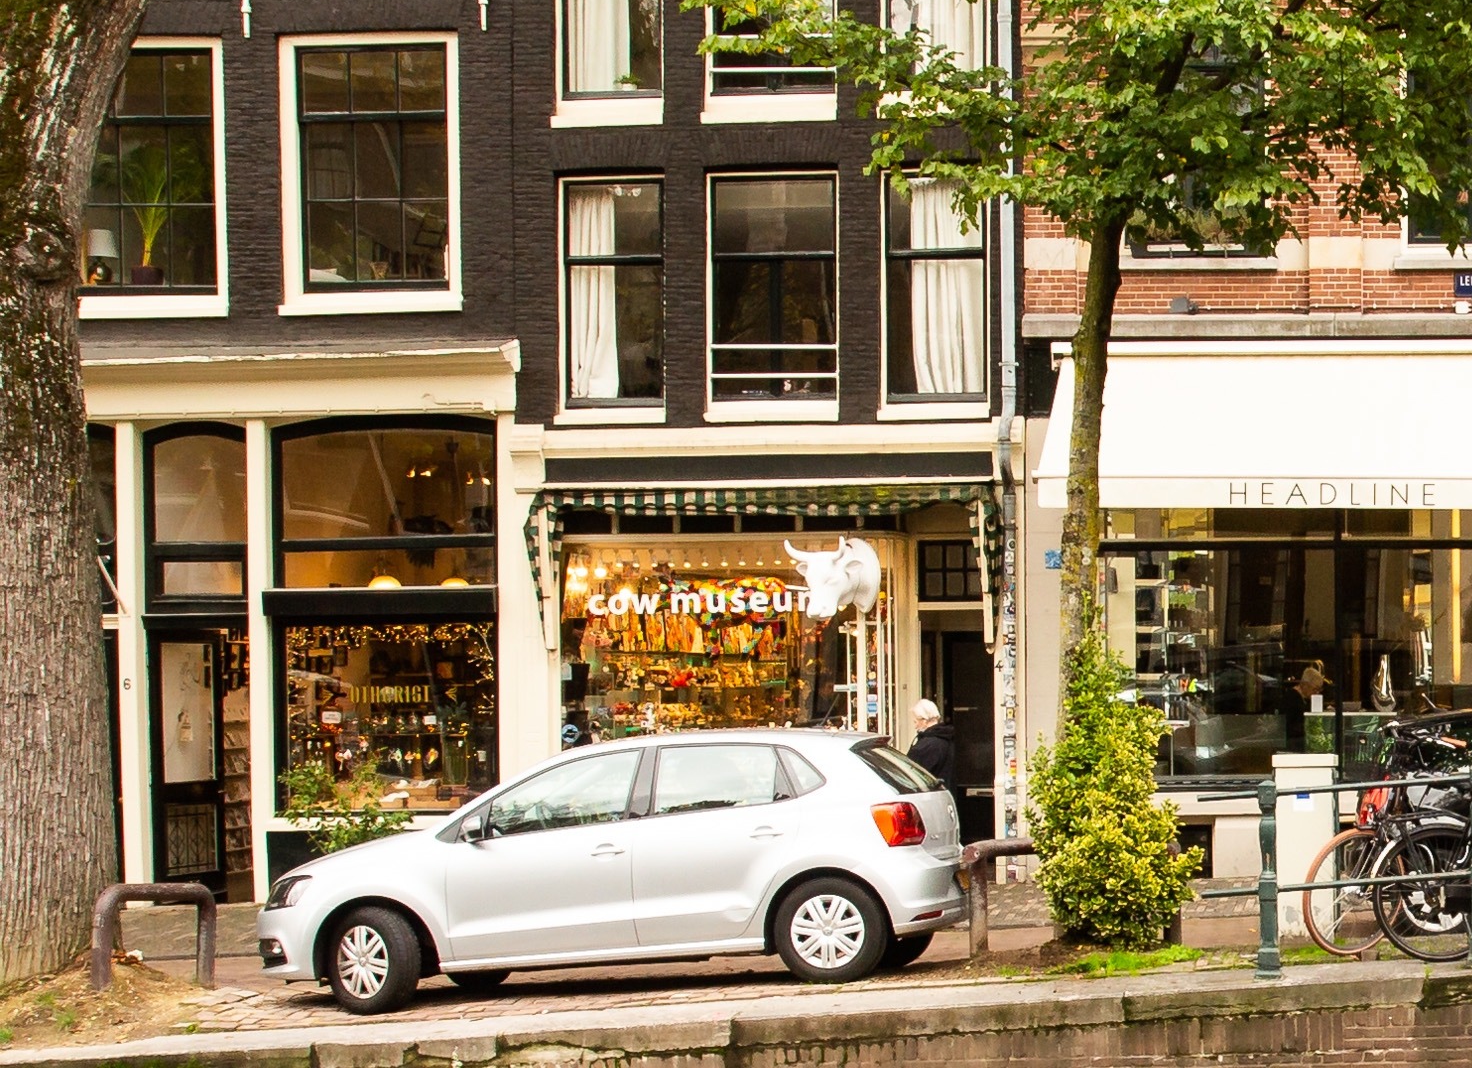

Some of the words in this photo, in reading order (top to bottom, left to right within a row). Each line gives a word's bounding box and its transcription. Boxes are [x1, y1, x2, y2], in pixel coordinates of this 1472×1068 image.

[1229, 482, 1436, 506] HEADLINE
[587, 590, 659, 615] cow
[123, 677, 131, 691] 6
